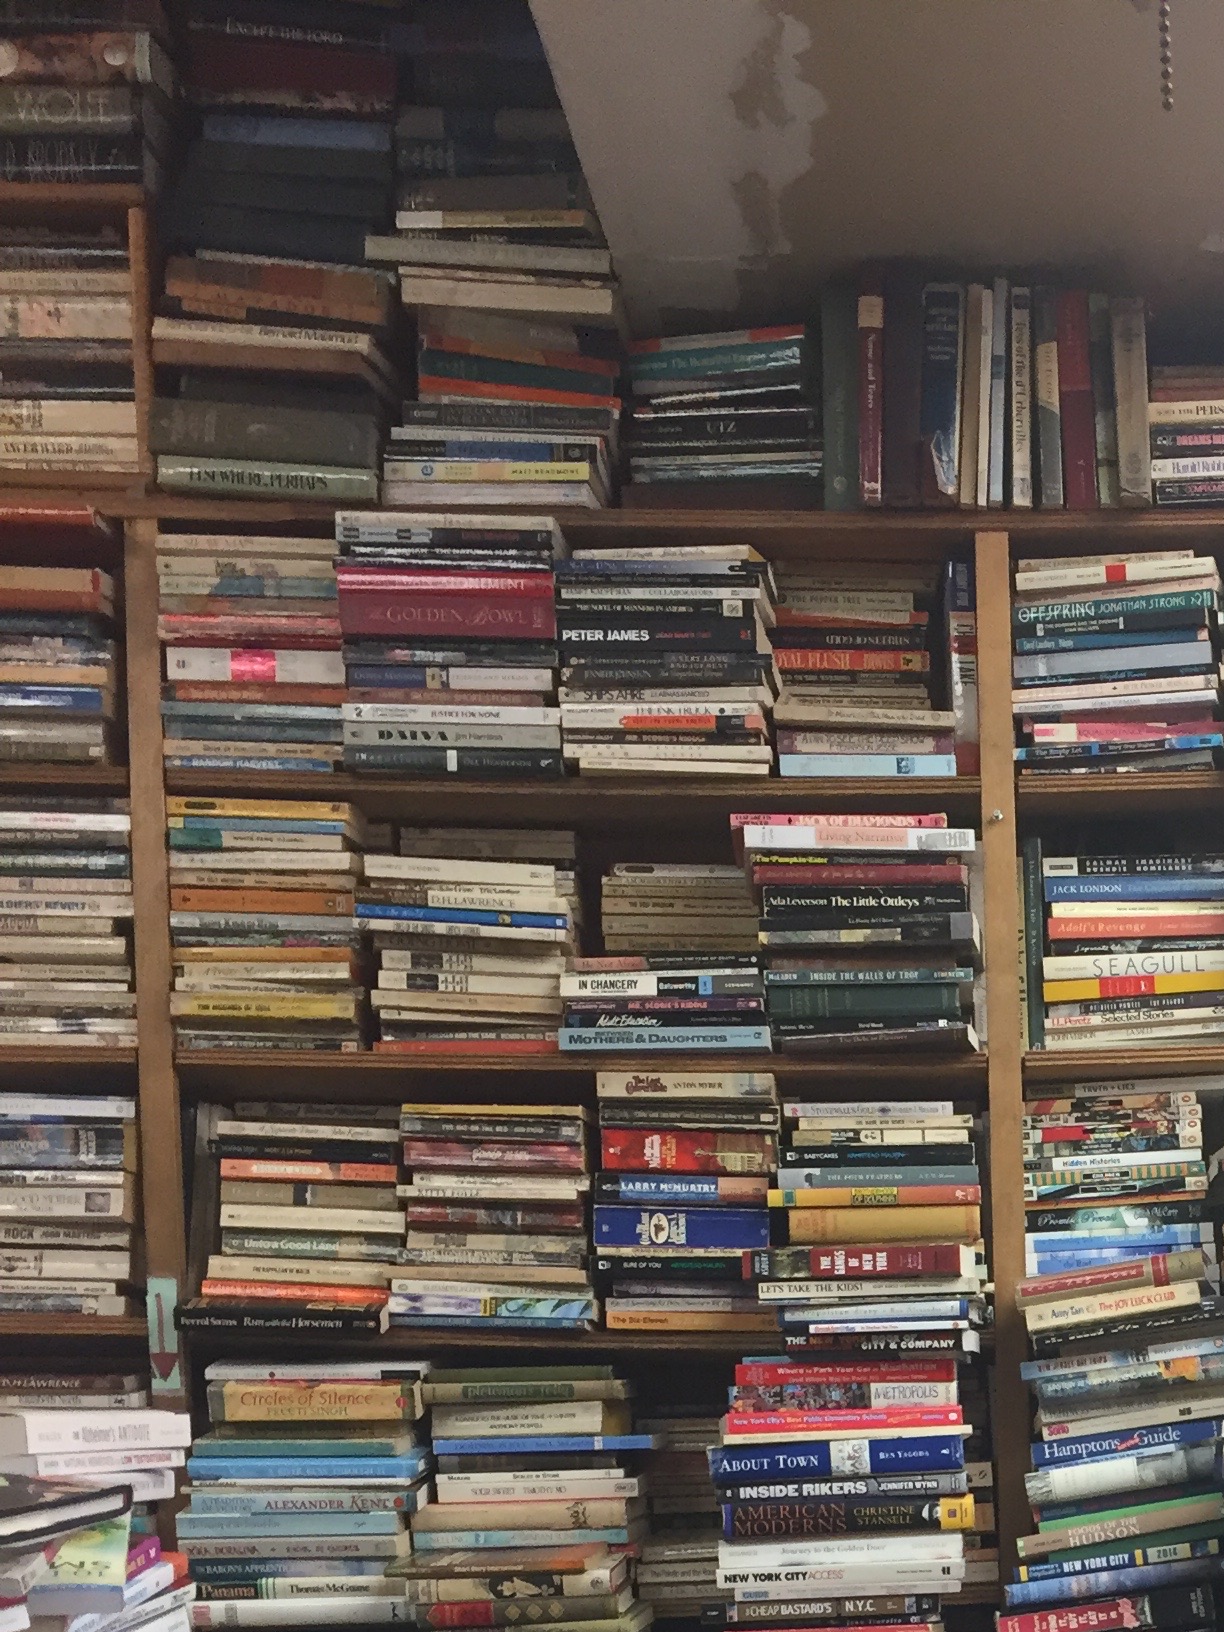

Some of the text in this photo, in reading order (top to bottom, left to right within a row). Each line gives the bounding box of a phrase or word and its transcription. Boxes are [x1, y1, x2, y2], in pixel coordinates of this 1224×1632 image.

[1019, 596, 1186, 624] OFFSPRING JONATHAN STRONG
[563, 629, 650, 643] PETER JAMES
[1093, 955, 1206, 977] SEAGULL
[568, 1032, 634, 1045] MOTHERS
[649, 1032, 728, 1044] DAUGHTERS
[760, 1282, 863, 1294] LET'S TAKE THE KIDS!
[861, 1340, 955, 1350] CITY & COMPANY
[240, 1390, 373, 1406] Circles of Silence
[874, 1384, 939, 1400] METROPOLIS
[1044, 1426, 1182, 1459] Hamptons Guide
[720, 1454, 819, 1473] ABOUT TOWN
[740, 1481, 868, 1499] INSIDE RIKERS
[264, 1494, 390, 1512] ALEXANDER KENT
[734, 1503, 846, 1521] AMERICAN
[734, 1518, 848, 1536] MODERNS
[724, 1571, 808, 1583] NEW YORK CITY
